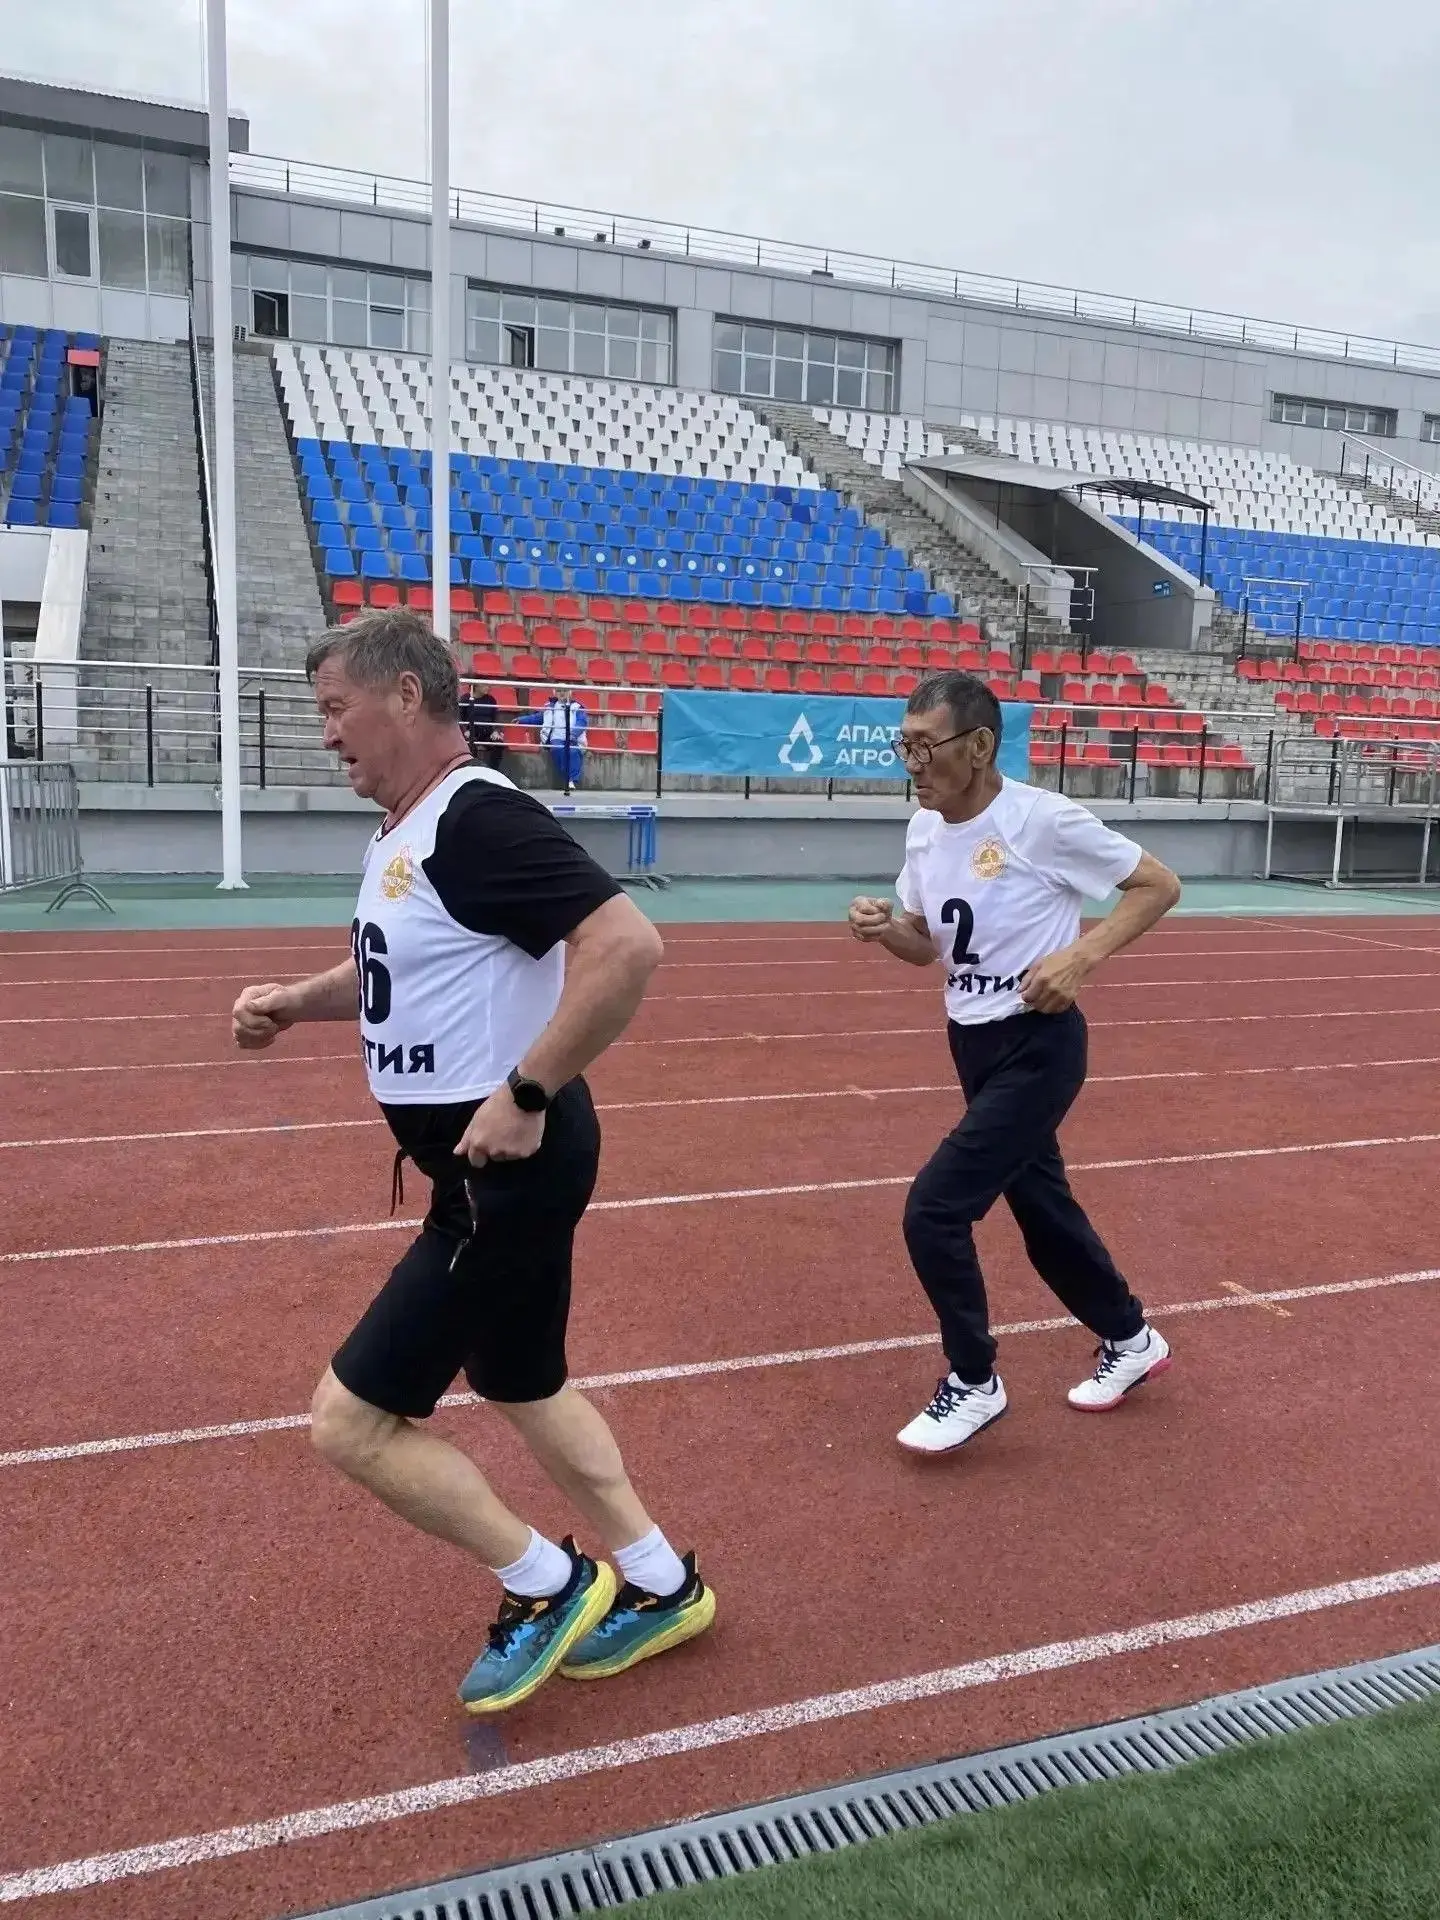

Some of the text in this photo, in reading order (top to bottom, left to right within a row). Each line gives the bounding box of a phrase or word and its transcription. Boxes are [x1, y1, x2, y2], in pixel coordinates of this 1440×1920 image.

[836, 725, 903, 743] АПАТ
[835, 748, 896, 767] АГРО
[941, 897, 981, 966] 2
[362, 1034, 435, 1074] ТИЯ
